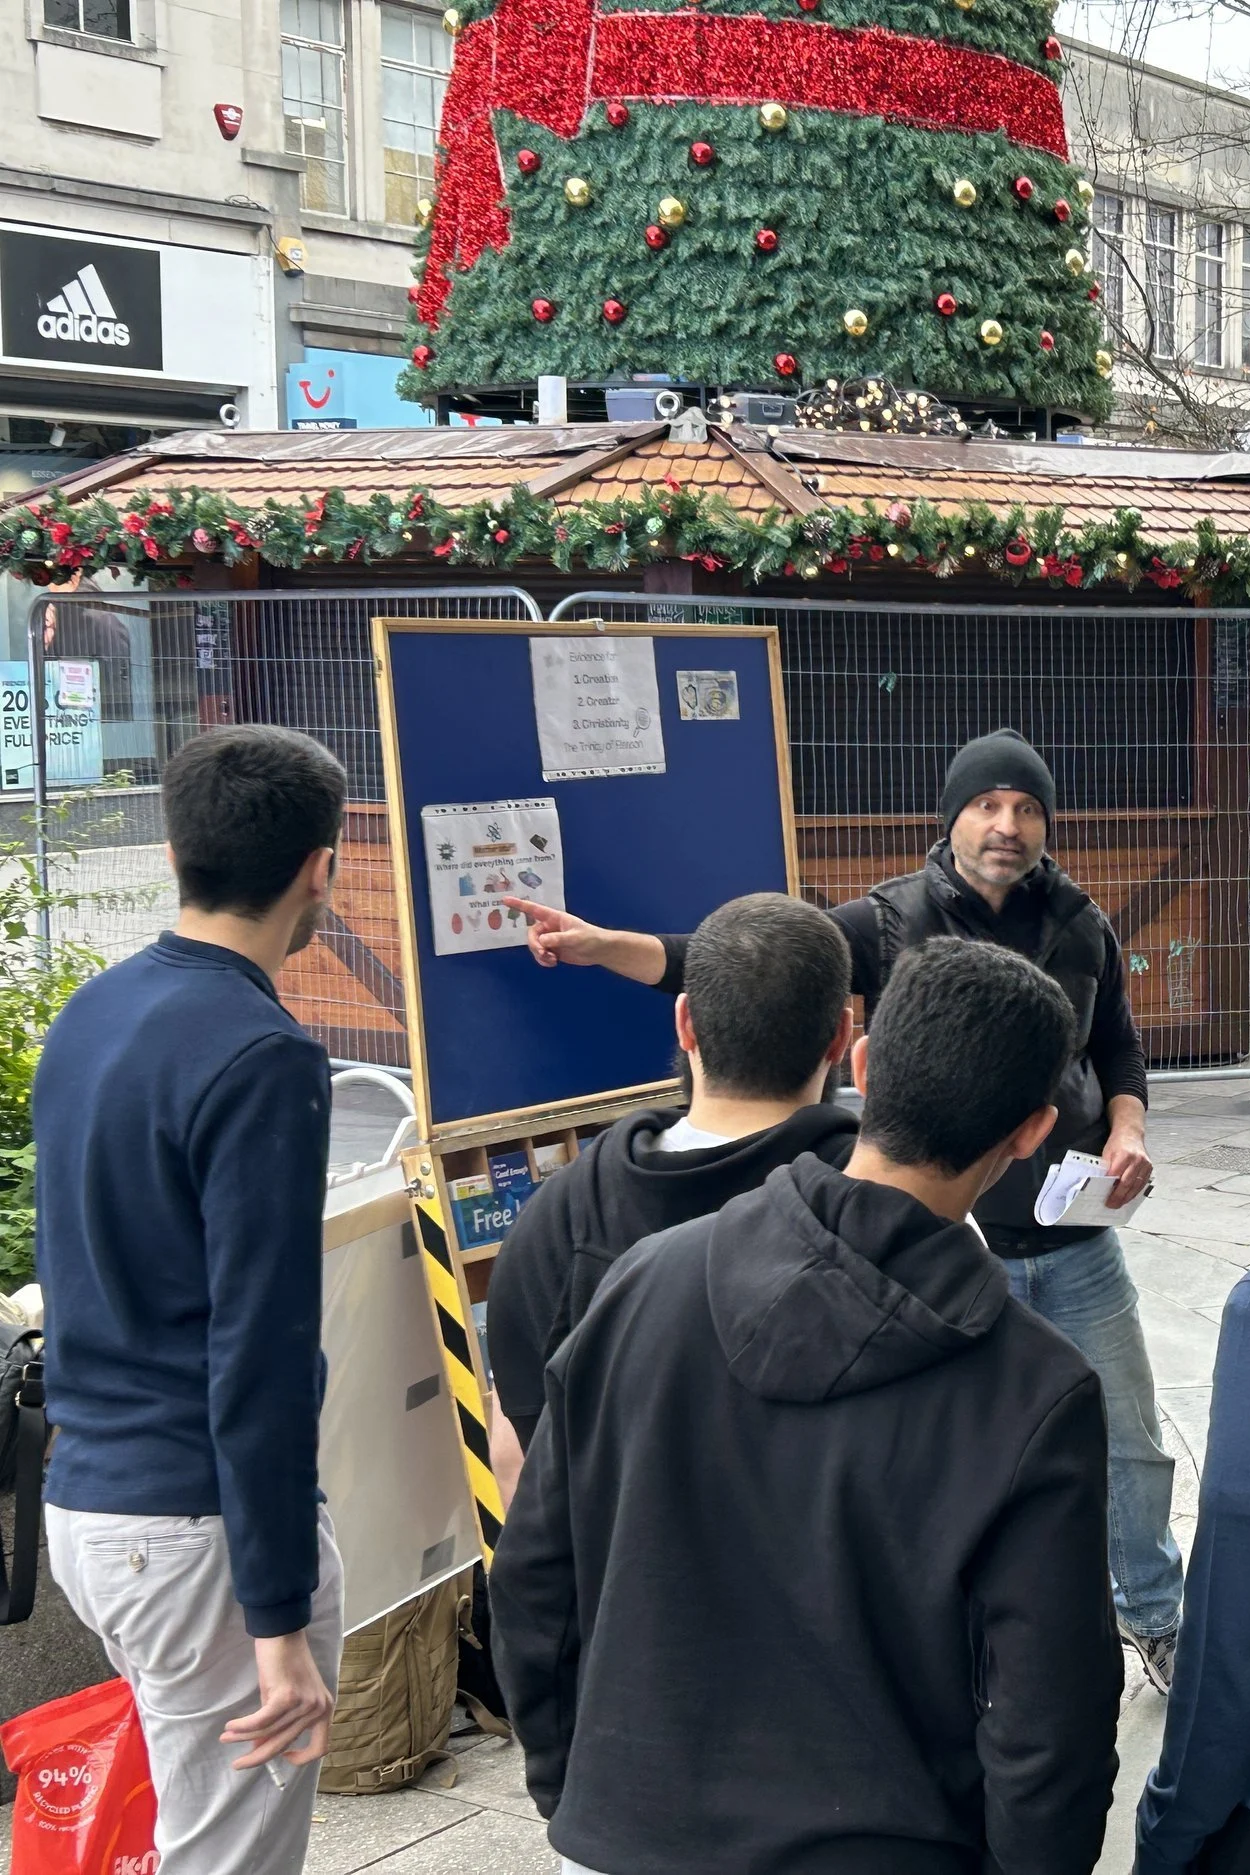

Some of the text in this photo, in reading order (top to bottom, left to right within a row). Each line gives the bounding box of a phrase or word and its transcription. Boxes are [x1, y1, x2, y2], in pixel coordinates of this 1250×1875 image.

[37, 311, 130, 346] adidas
[4, 713, 88, 730] EVETHING
[473, 857, 514, 869] everything
[473, 1208, 514, 1233] Free
[38, 1765, 93, 1789] 94%
[33, 1792, 70, 1814] RECYCLED
